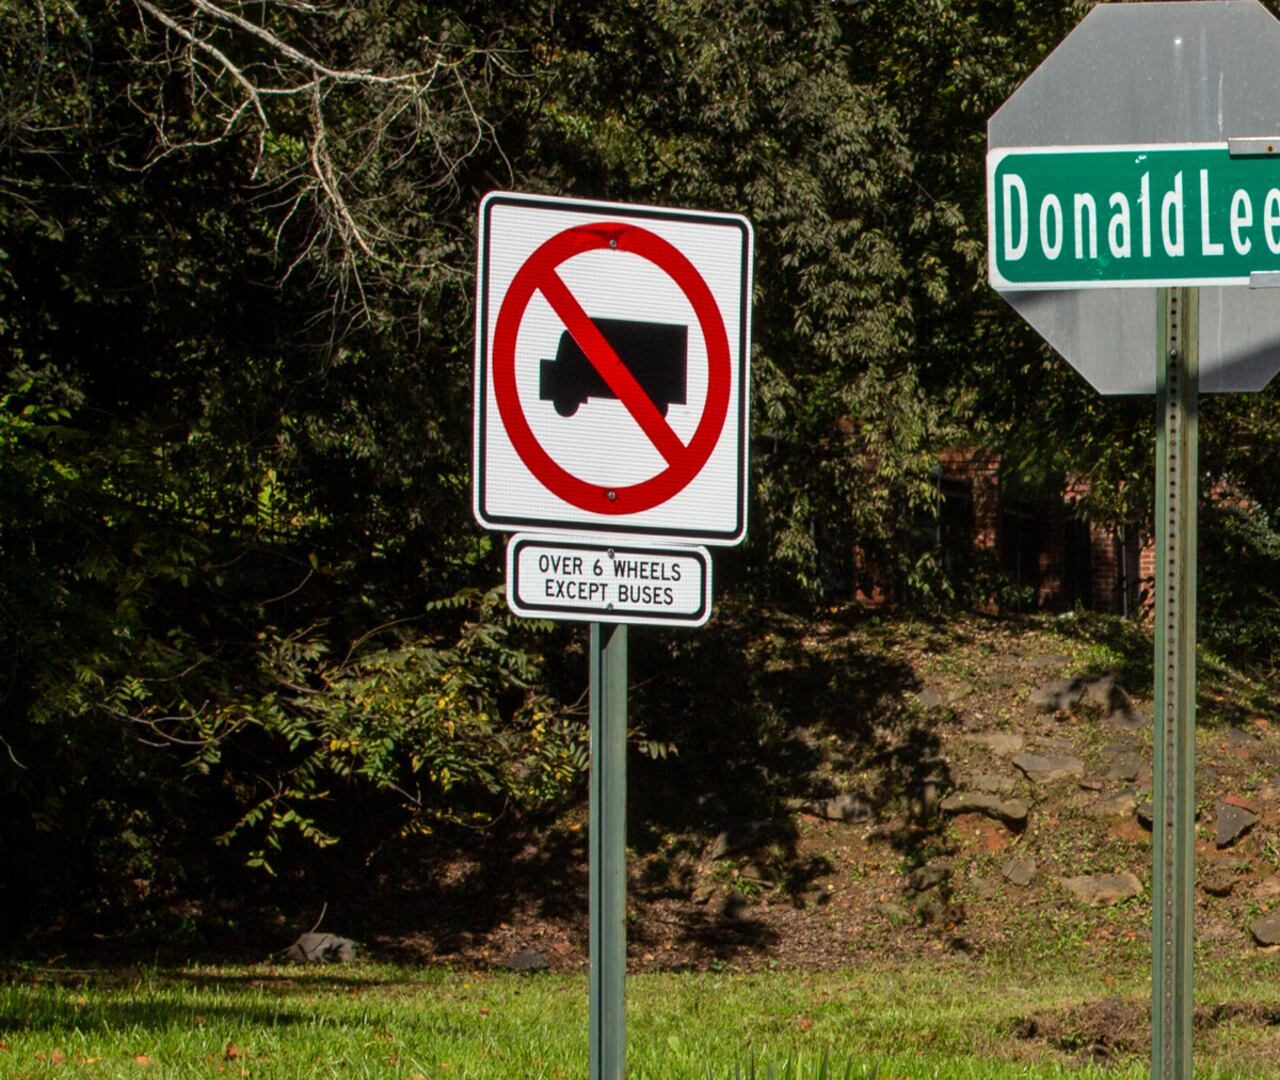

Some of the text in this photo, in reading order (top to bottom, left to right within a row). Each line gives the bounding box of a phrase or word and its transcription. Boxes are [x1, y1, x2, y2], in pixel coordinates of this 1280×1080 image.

[1002, 170, 1185, 261] Donald
[538, 554, 682, 582] OVER 6 WHEELS
[545, 578, 674, 606] EXCEPT BUSES
